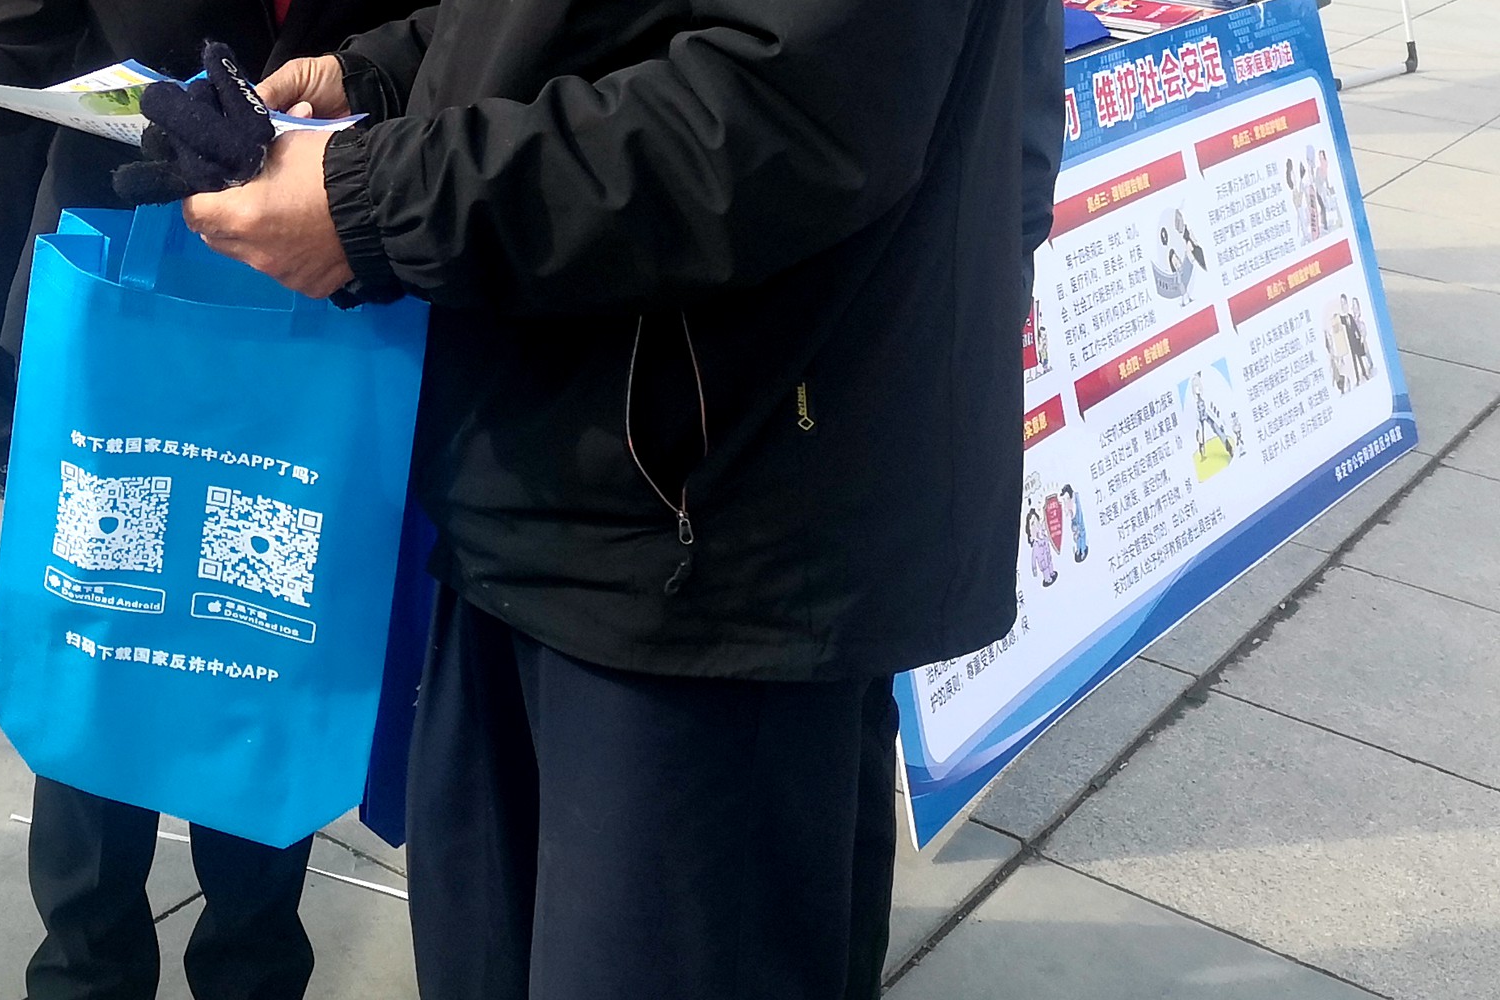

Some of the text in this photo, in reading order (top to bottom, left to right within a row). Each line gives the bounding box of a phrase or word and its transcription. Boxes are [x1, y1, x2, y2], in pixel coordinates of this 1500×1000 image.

[1094, 38, 1225, 126] 维护社会安定
[1234, 41, 1294, 82] 反家庭暴力法
[61, 587, 160, 611] Download Android
[224, 609, 278, 631] Download
[66, 630, 280, 683] 扫码下载国家反诈中心APP
